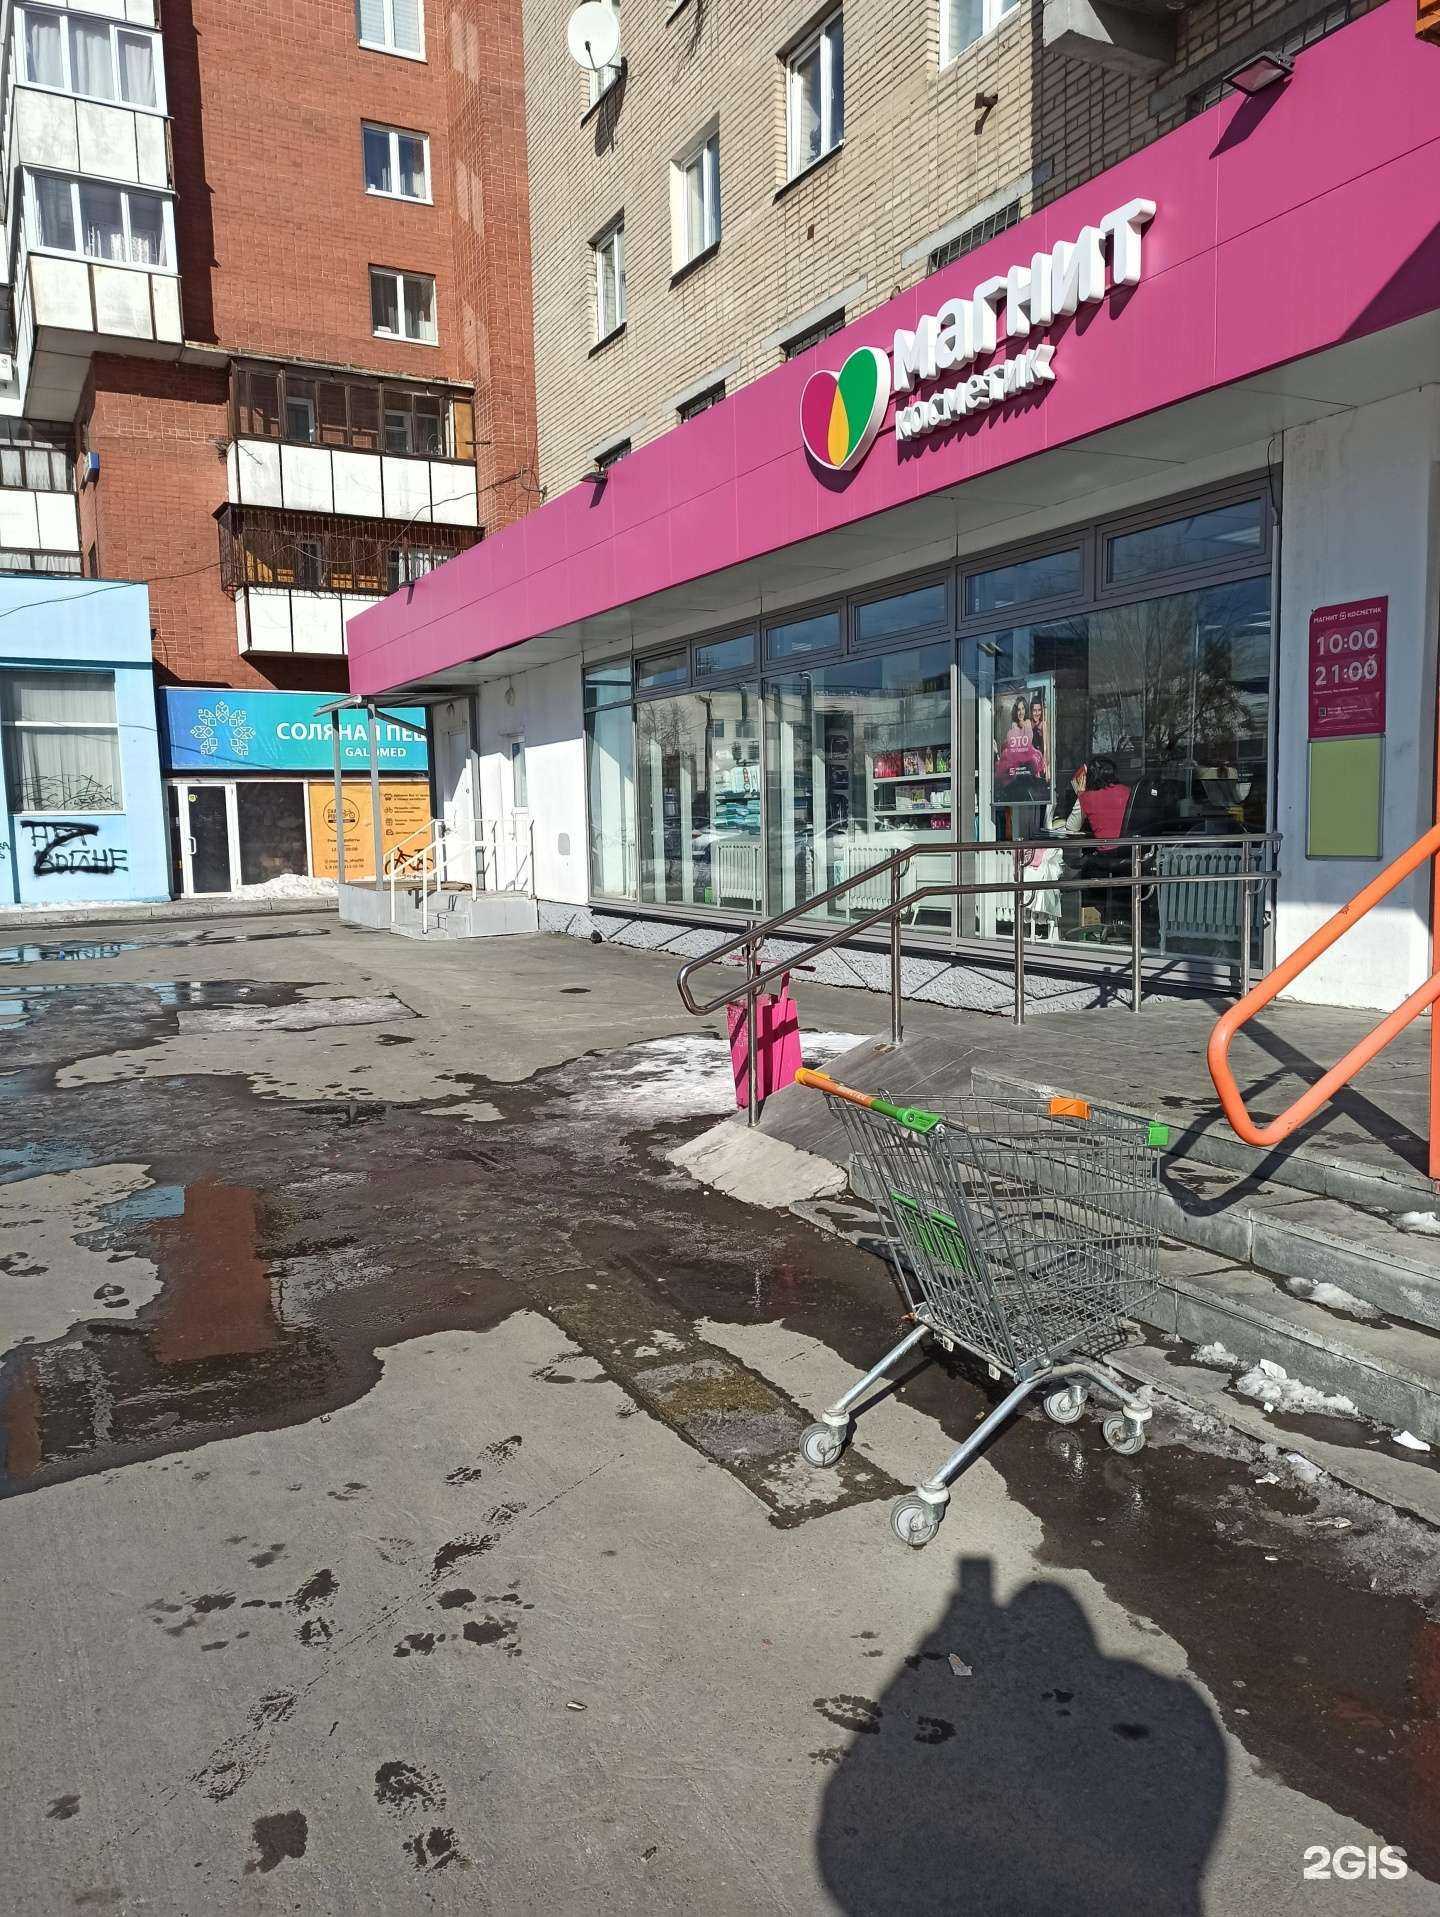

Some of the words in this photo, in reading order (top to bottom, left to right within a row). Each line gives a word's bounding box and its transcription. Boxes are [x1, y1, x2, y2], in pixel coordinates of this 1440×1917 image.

[1313, 614, 1338, 624] МАГНИТ
[1317, 628, 1378, 656] 10:00
[1315, 660, 1378, 686] 21:00
[1010, 735, 1029, 748] ЭТО
[345, 747, 407, 758] GALMED
